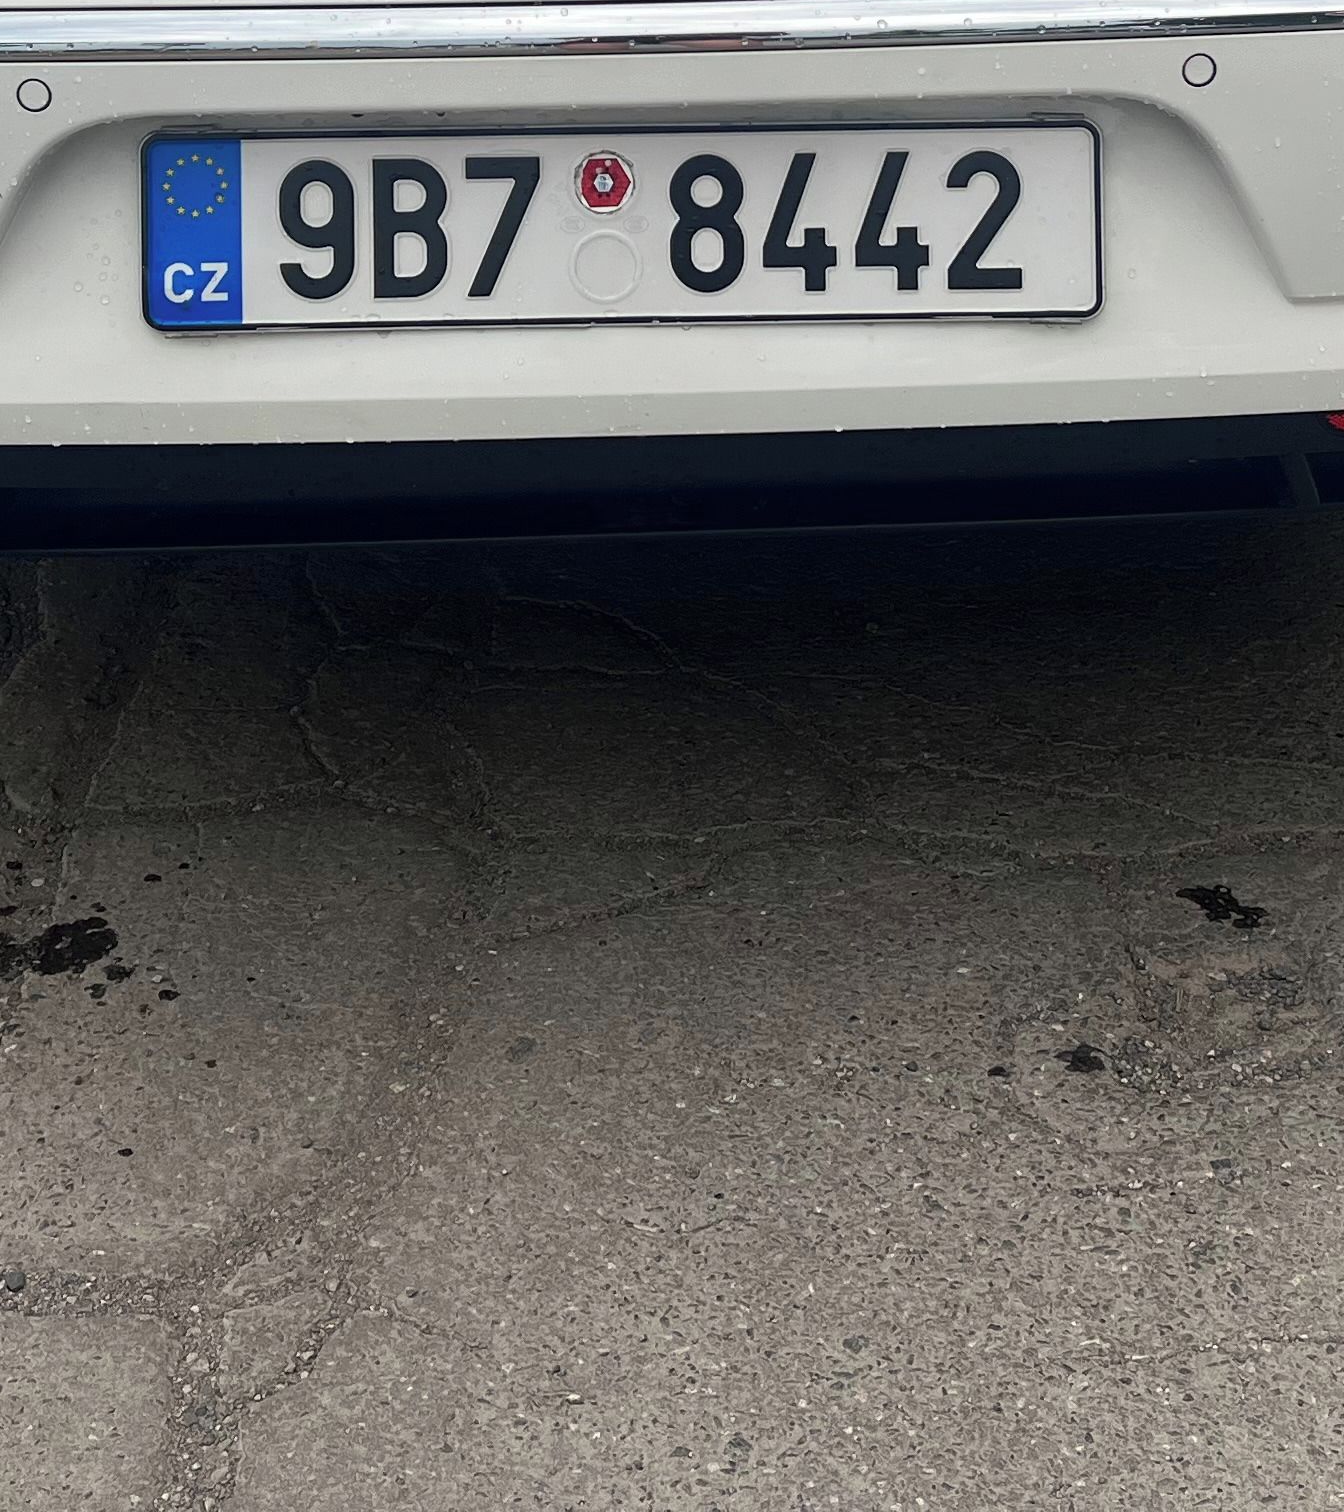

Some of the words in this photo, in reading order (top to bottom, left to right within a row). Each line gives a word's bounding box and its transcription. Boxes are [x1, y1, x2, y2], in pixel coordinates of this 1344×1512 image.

[278, 156, 541, 299] 9B7
[668, 151, 1023, 293] 8442
[163, 262, 229, 303] CZ
